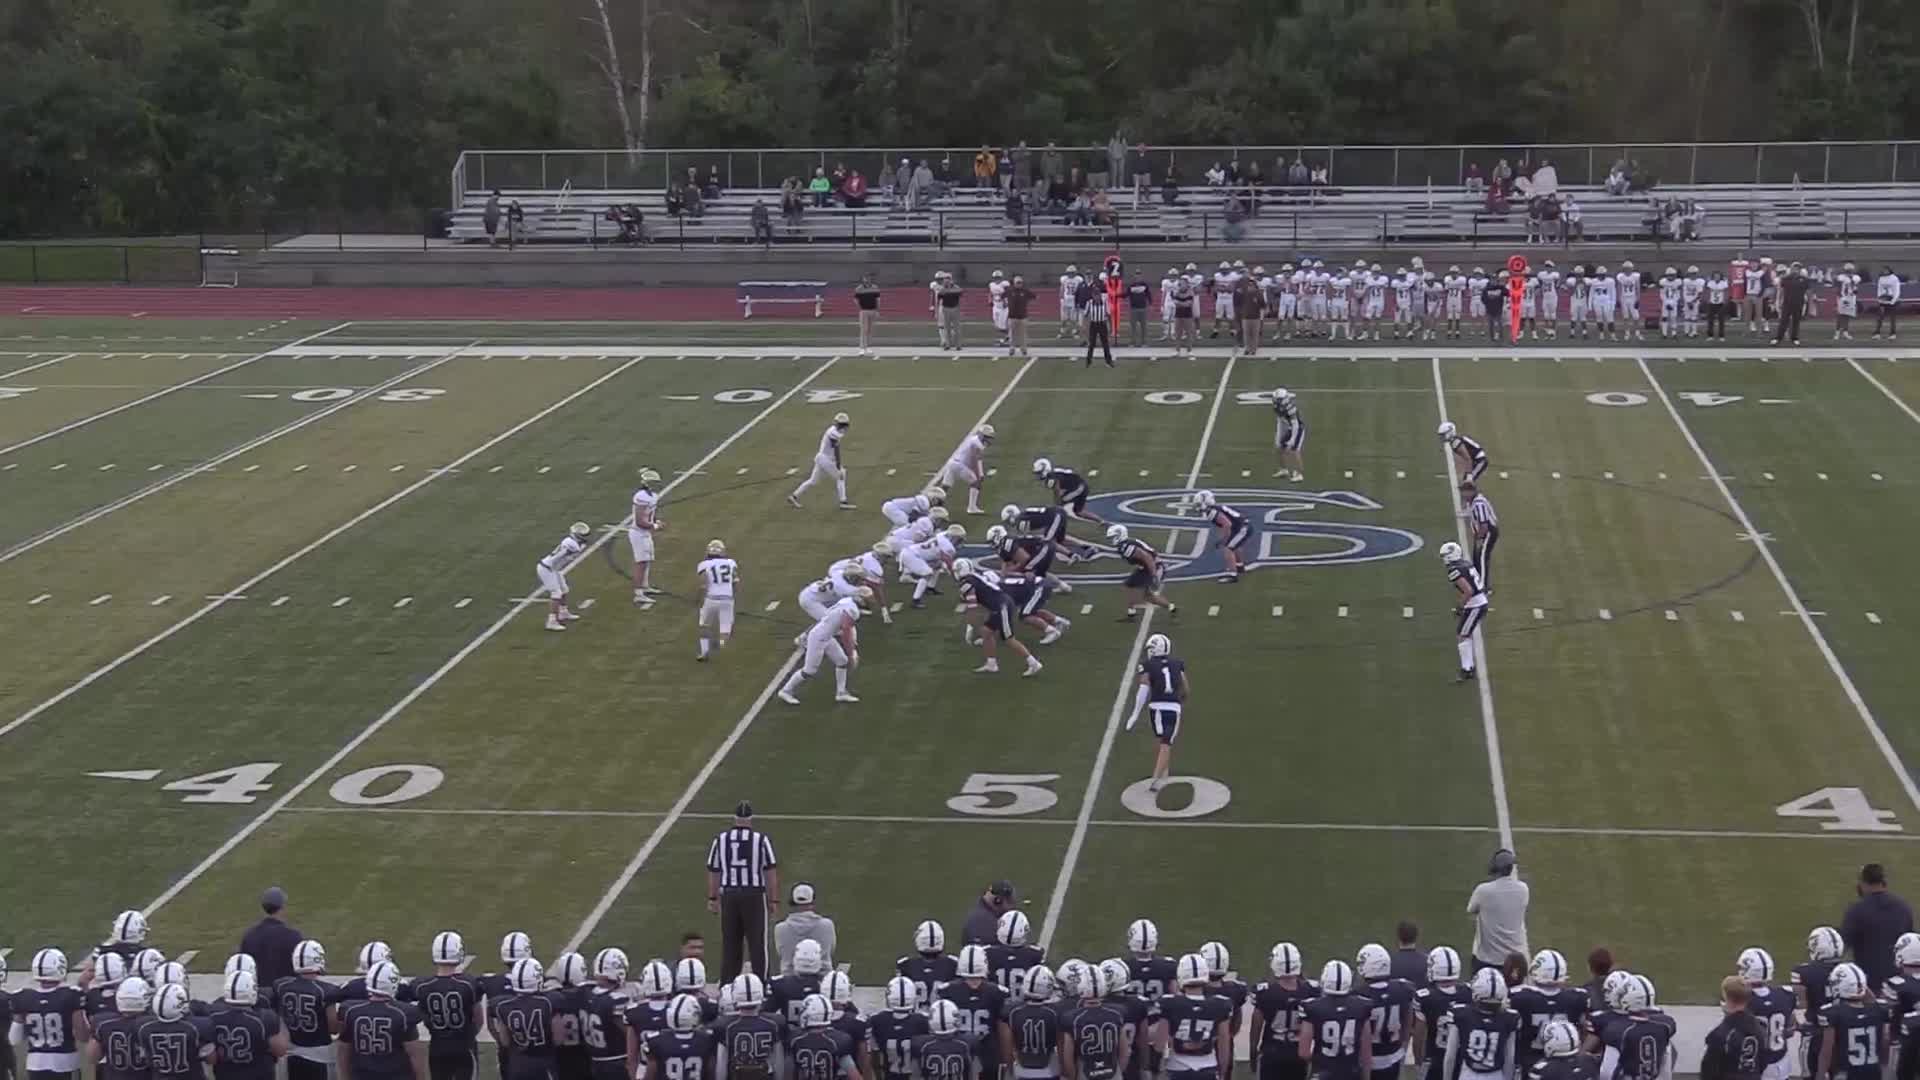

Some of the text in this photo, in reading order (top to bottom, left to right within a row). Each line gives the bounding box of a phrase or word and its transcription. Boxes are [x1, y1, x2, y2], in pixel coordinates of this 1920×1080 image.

[712, 564, 731, 583] 12
[1162, 667, 1174, 692] 1
[1776, 787, 1903, 830] 4
[731, 842, 747, 866] L
[428, 991, 463, 1030] 98
[508, 1009, 545, 1047] 94
[26, 1012, 63, 1048] 38
[354, 1016, 393, 1055] 65
[1022, 1018, 1047, 1054] 11
[1081, 1023, 1119, 1055] 20
[1322, 1020, 1356, 1057] 94
[1848, 1026, 1879, 1066] 51
[150, 1032, 190, 1074] 57
